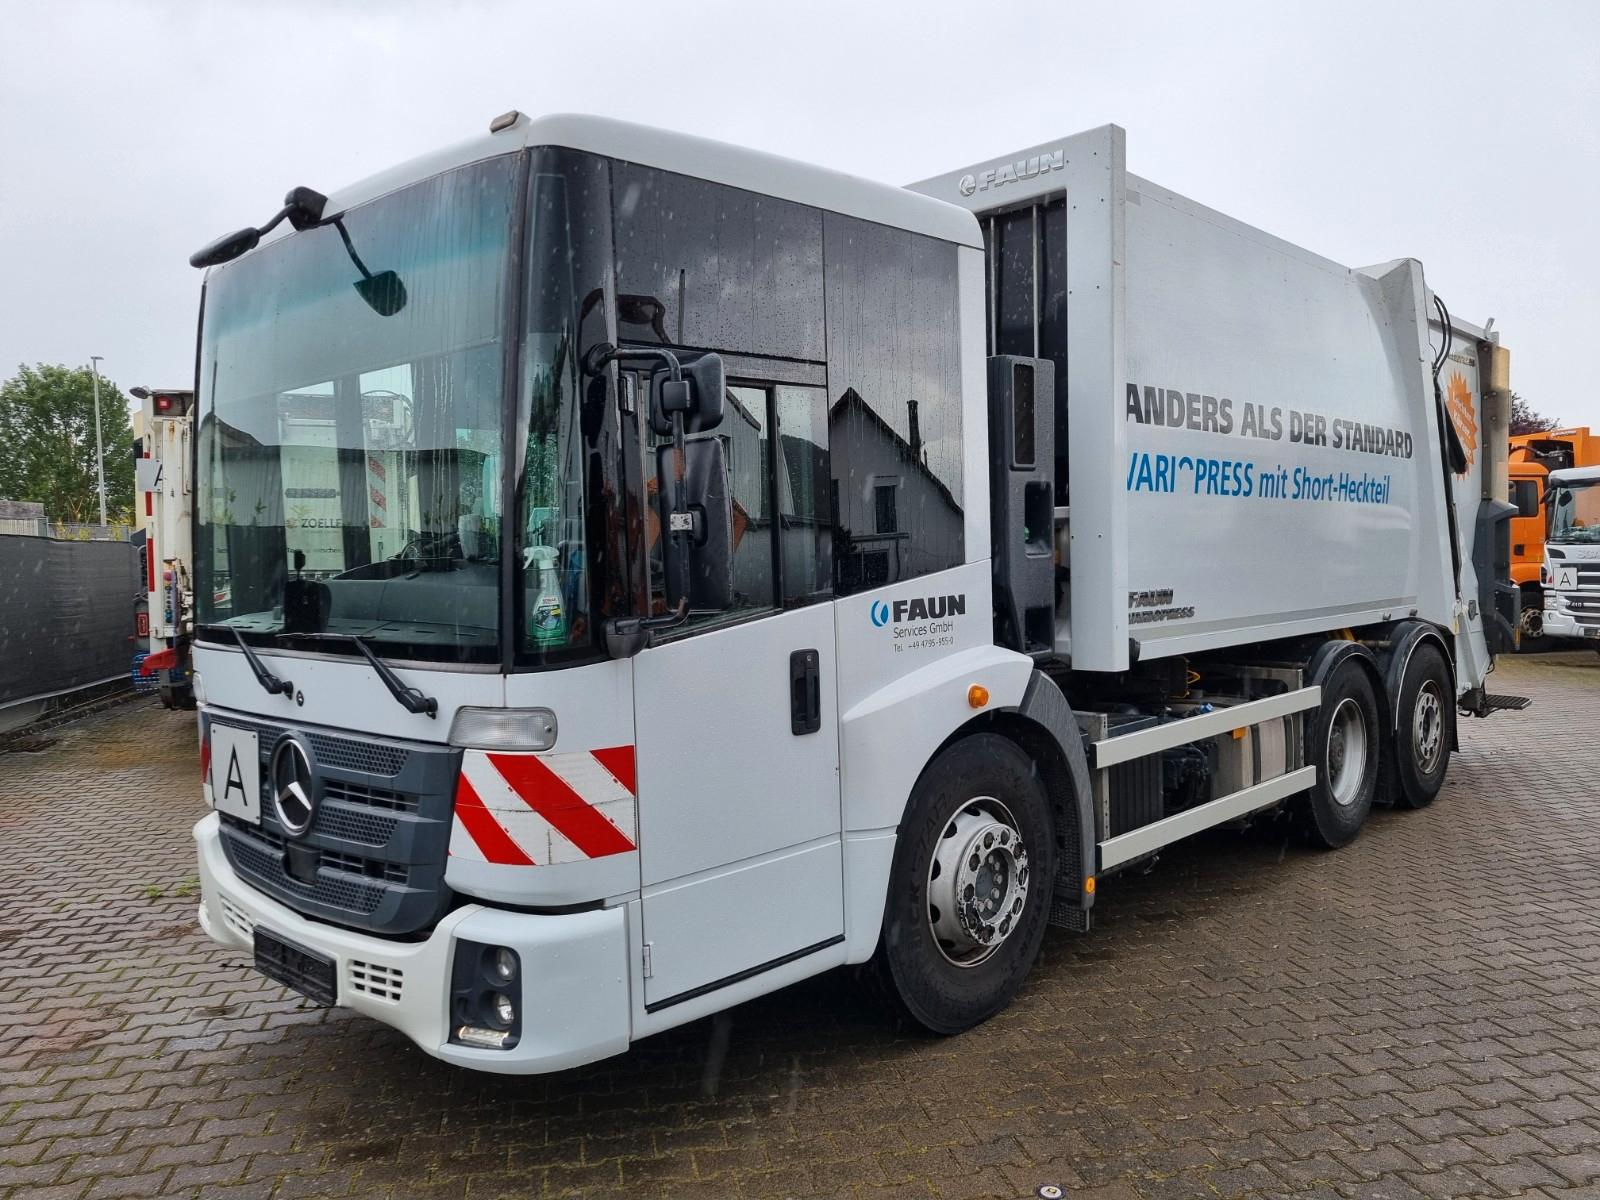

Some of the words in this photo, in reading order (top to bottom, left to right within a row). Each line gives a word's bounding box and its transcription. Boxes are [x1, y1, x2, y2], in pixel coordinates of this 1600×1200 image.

[979, 149, 1064, 192] FAUN
[1126, 382, 1234, 435] ANDERS
[1240, 402, 1283, 441] ALS
[1290, 410, 1327, 447] DER
[1332, 418, 1413, 460] STANDARD
[1258, 464, 1288, 499] mit
[1292, 467, 1391, 505] Short-Heckteil
[1560, 572, 1571, 587] A
[892, 594, 966, 623] FAUN
[893, 625, 928, 639] Services
[929, 621, 953, 634] GmbH
[224, 743, 248, 807] A
